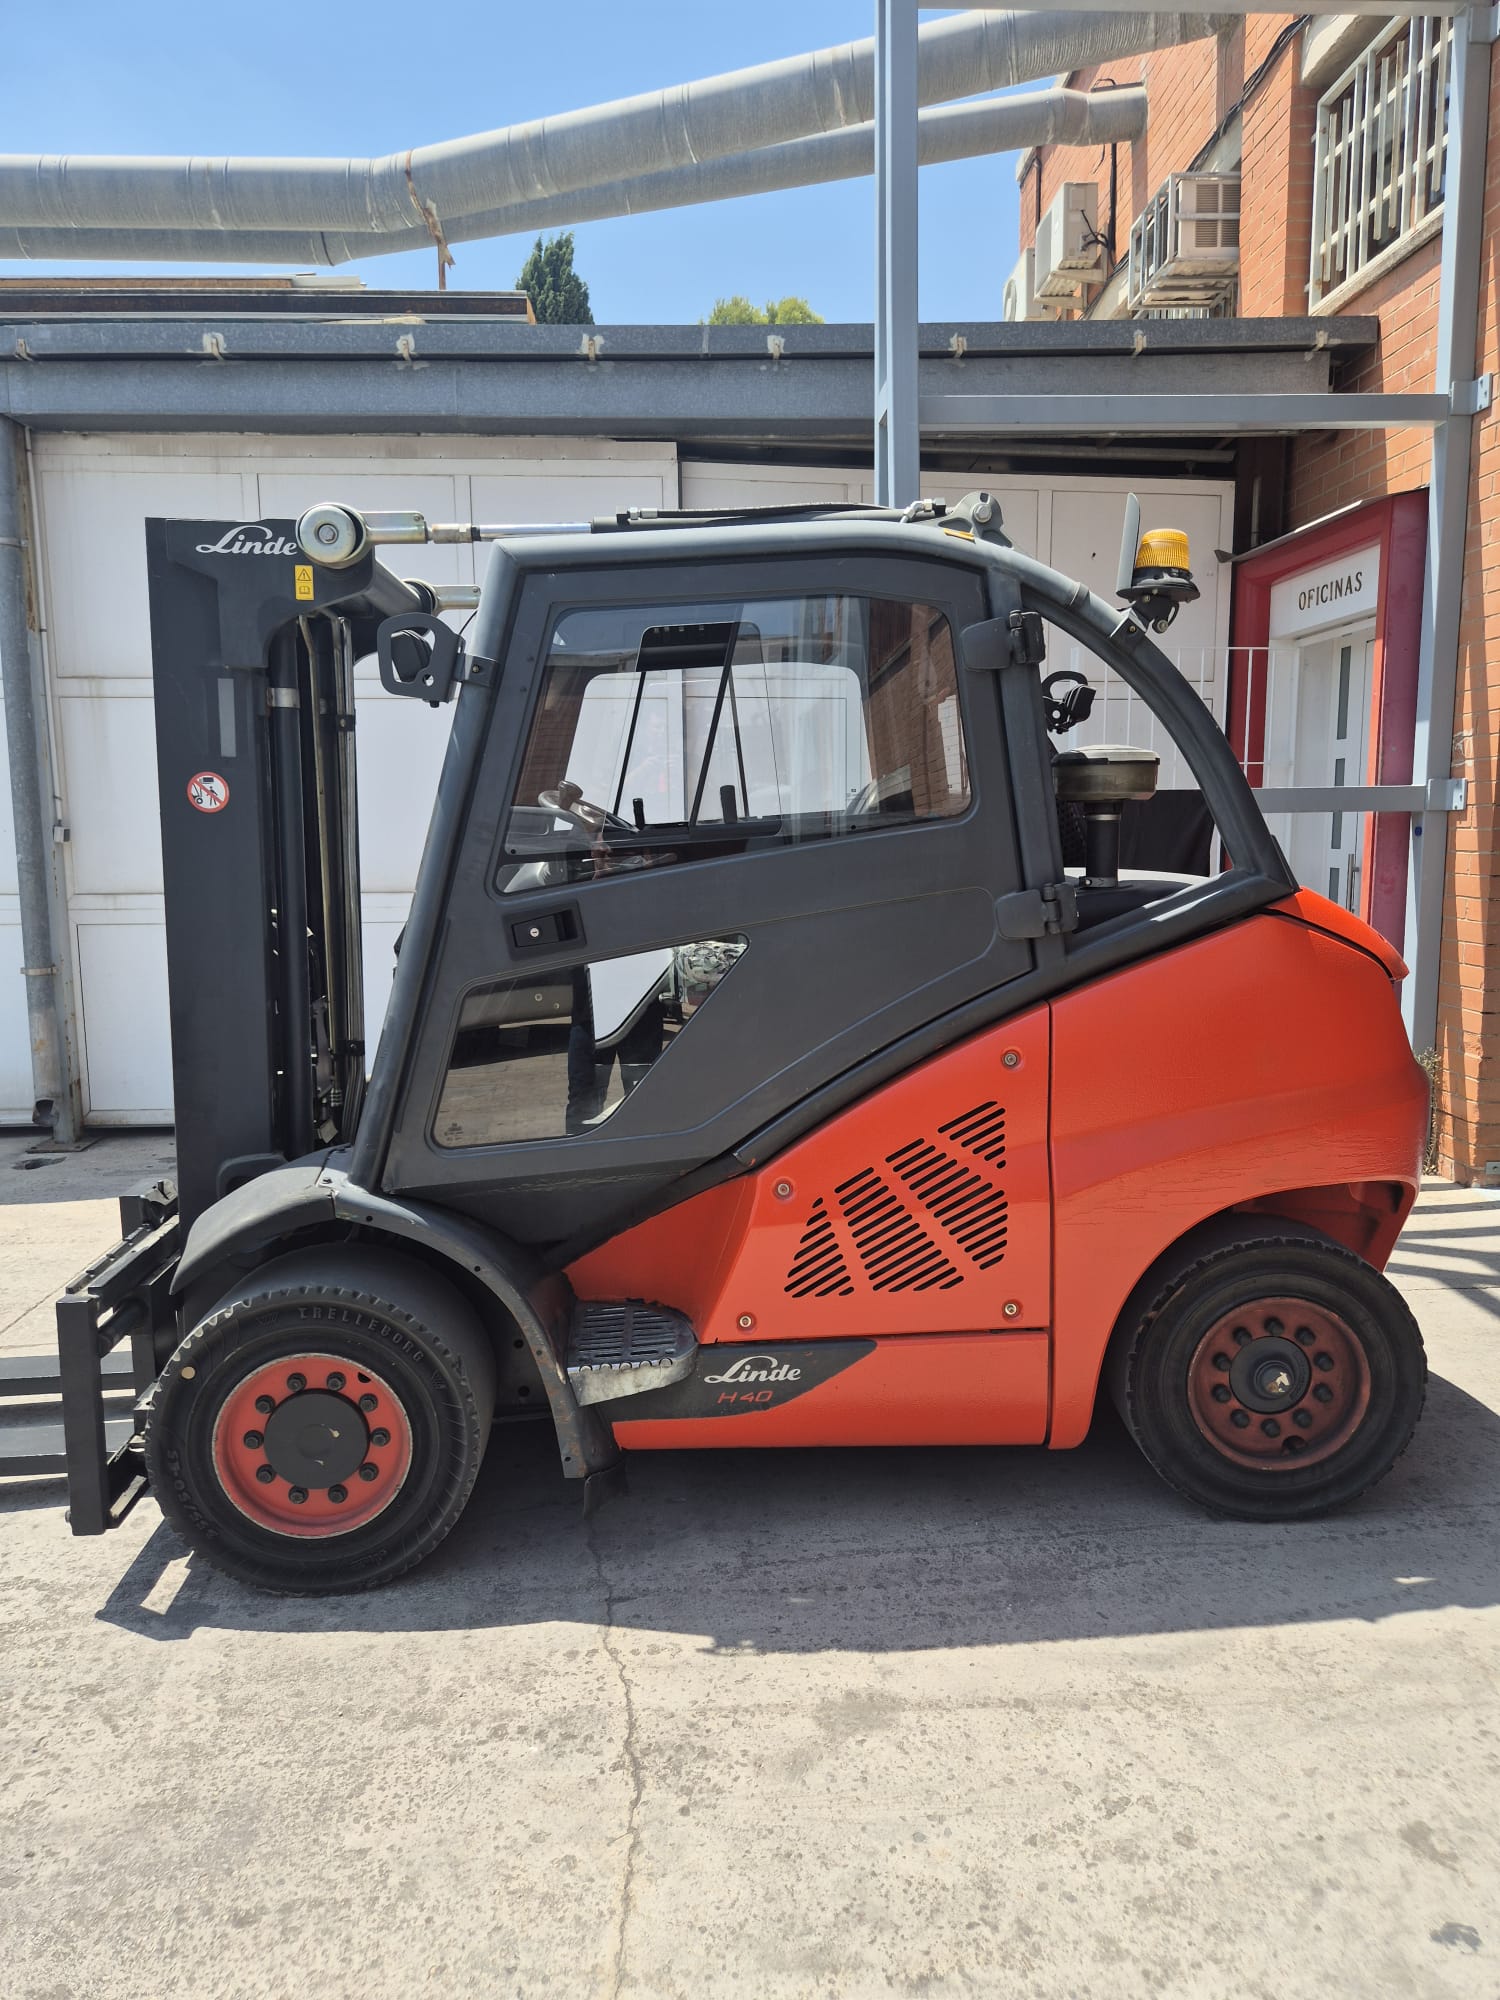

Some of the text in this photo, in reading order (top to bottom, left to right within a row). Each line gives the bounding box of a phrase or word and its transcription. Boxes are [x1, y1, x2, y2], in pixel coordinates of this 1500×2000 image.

[195, 525, 298, 556] Linde
[1298, 571, 1363, 611] OFICINAS
[298, 1306, 425, 1363] TRELLEBORG
[703, 1355, 802, 1384] Linde
